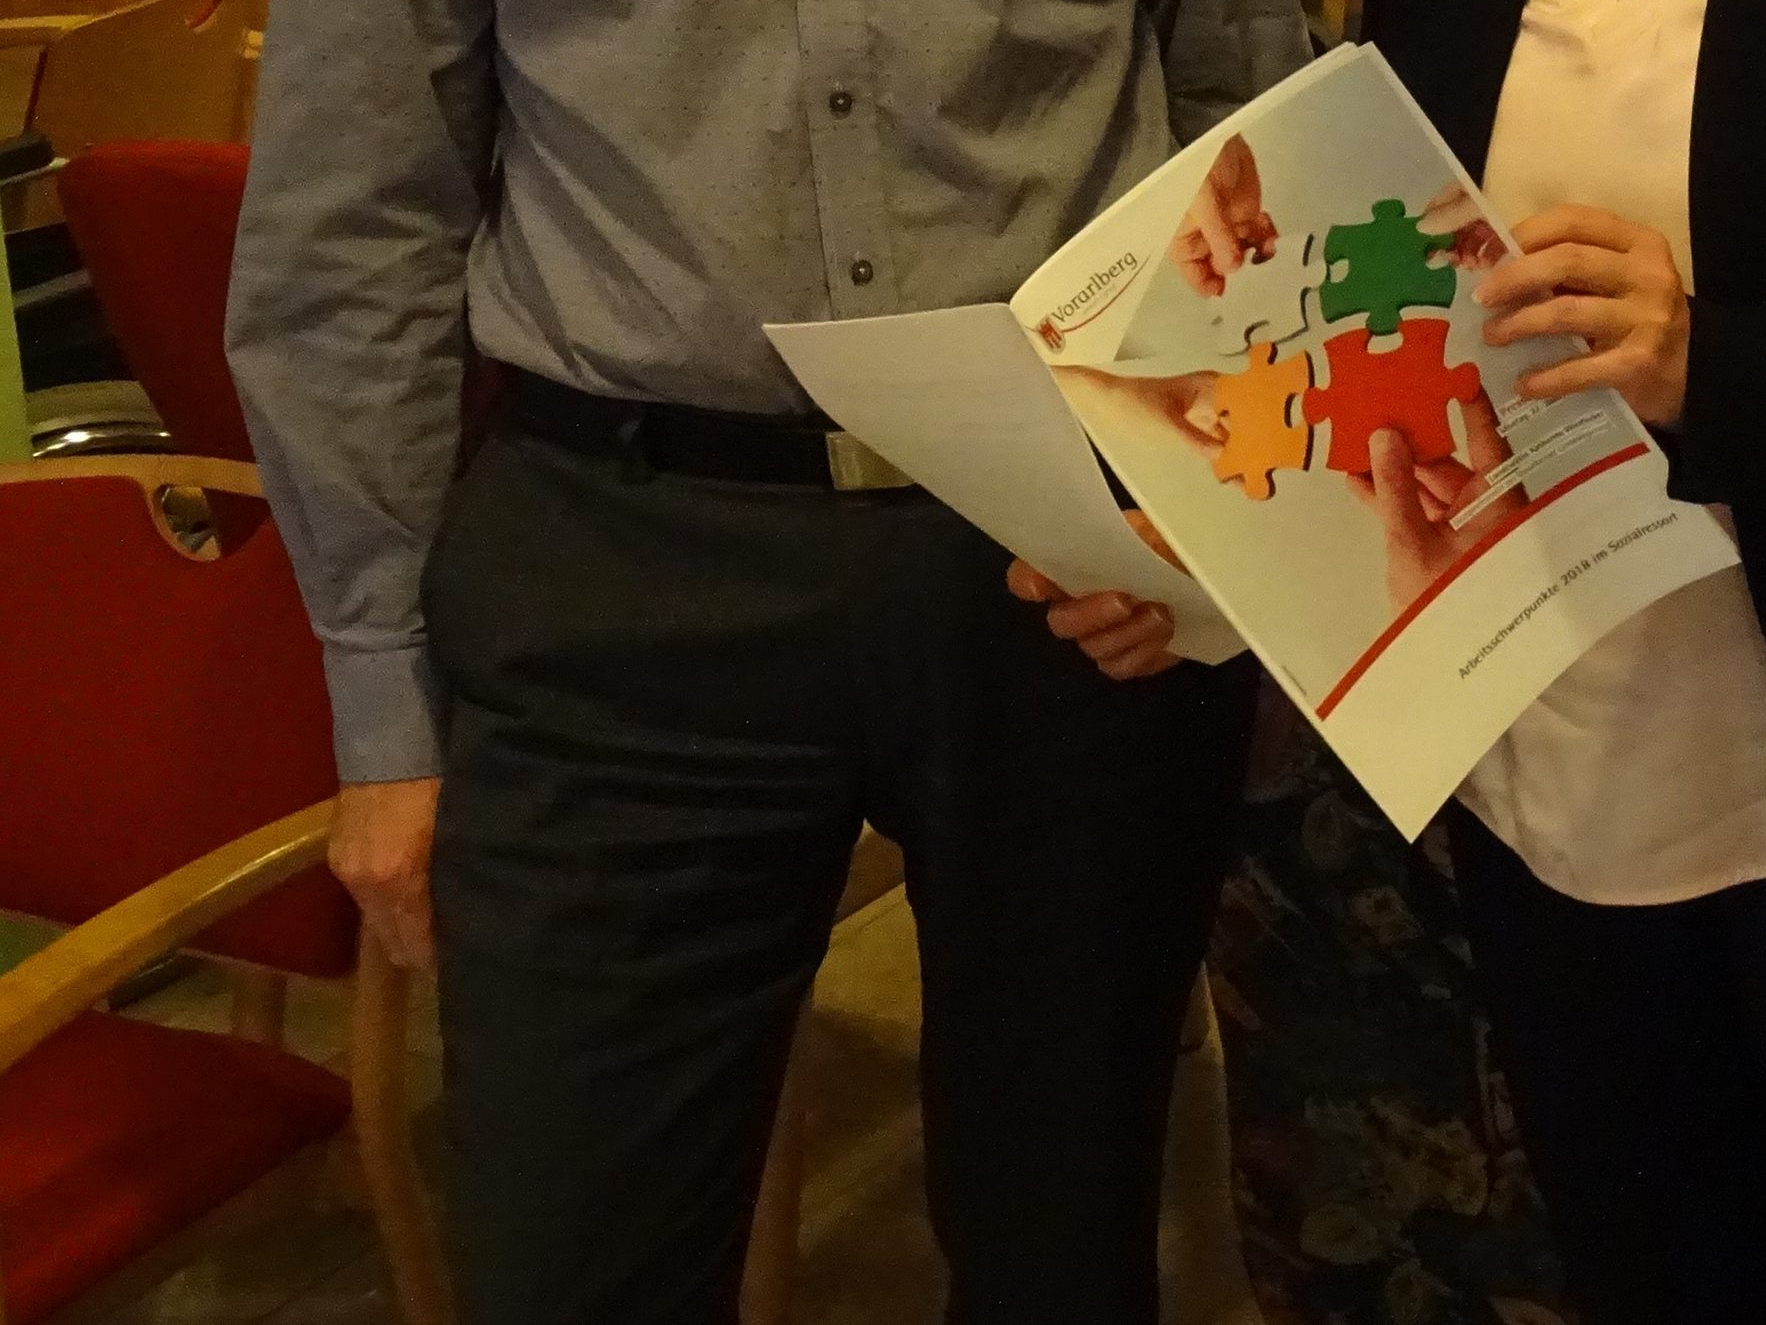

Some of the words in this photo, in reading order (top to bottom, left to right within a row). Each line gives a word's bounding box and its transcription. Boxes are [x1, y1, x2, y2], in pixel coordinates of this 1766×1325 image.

[1051, 252, 1138, 323] Vorarlberg
[1458, 583, 1560, 679] Arbeitsschwerpunkte
[1560, 559, 1591, 586] 2018
[1592, 548, 1608, 564] im
[1607, 512, 1679, 552] Sozialressort
